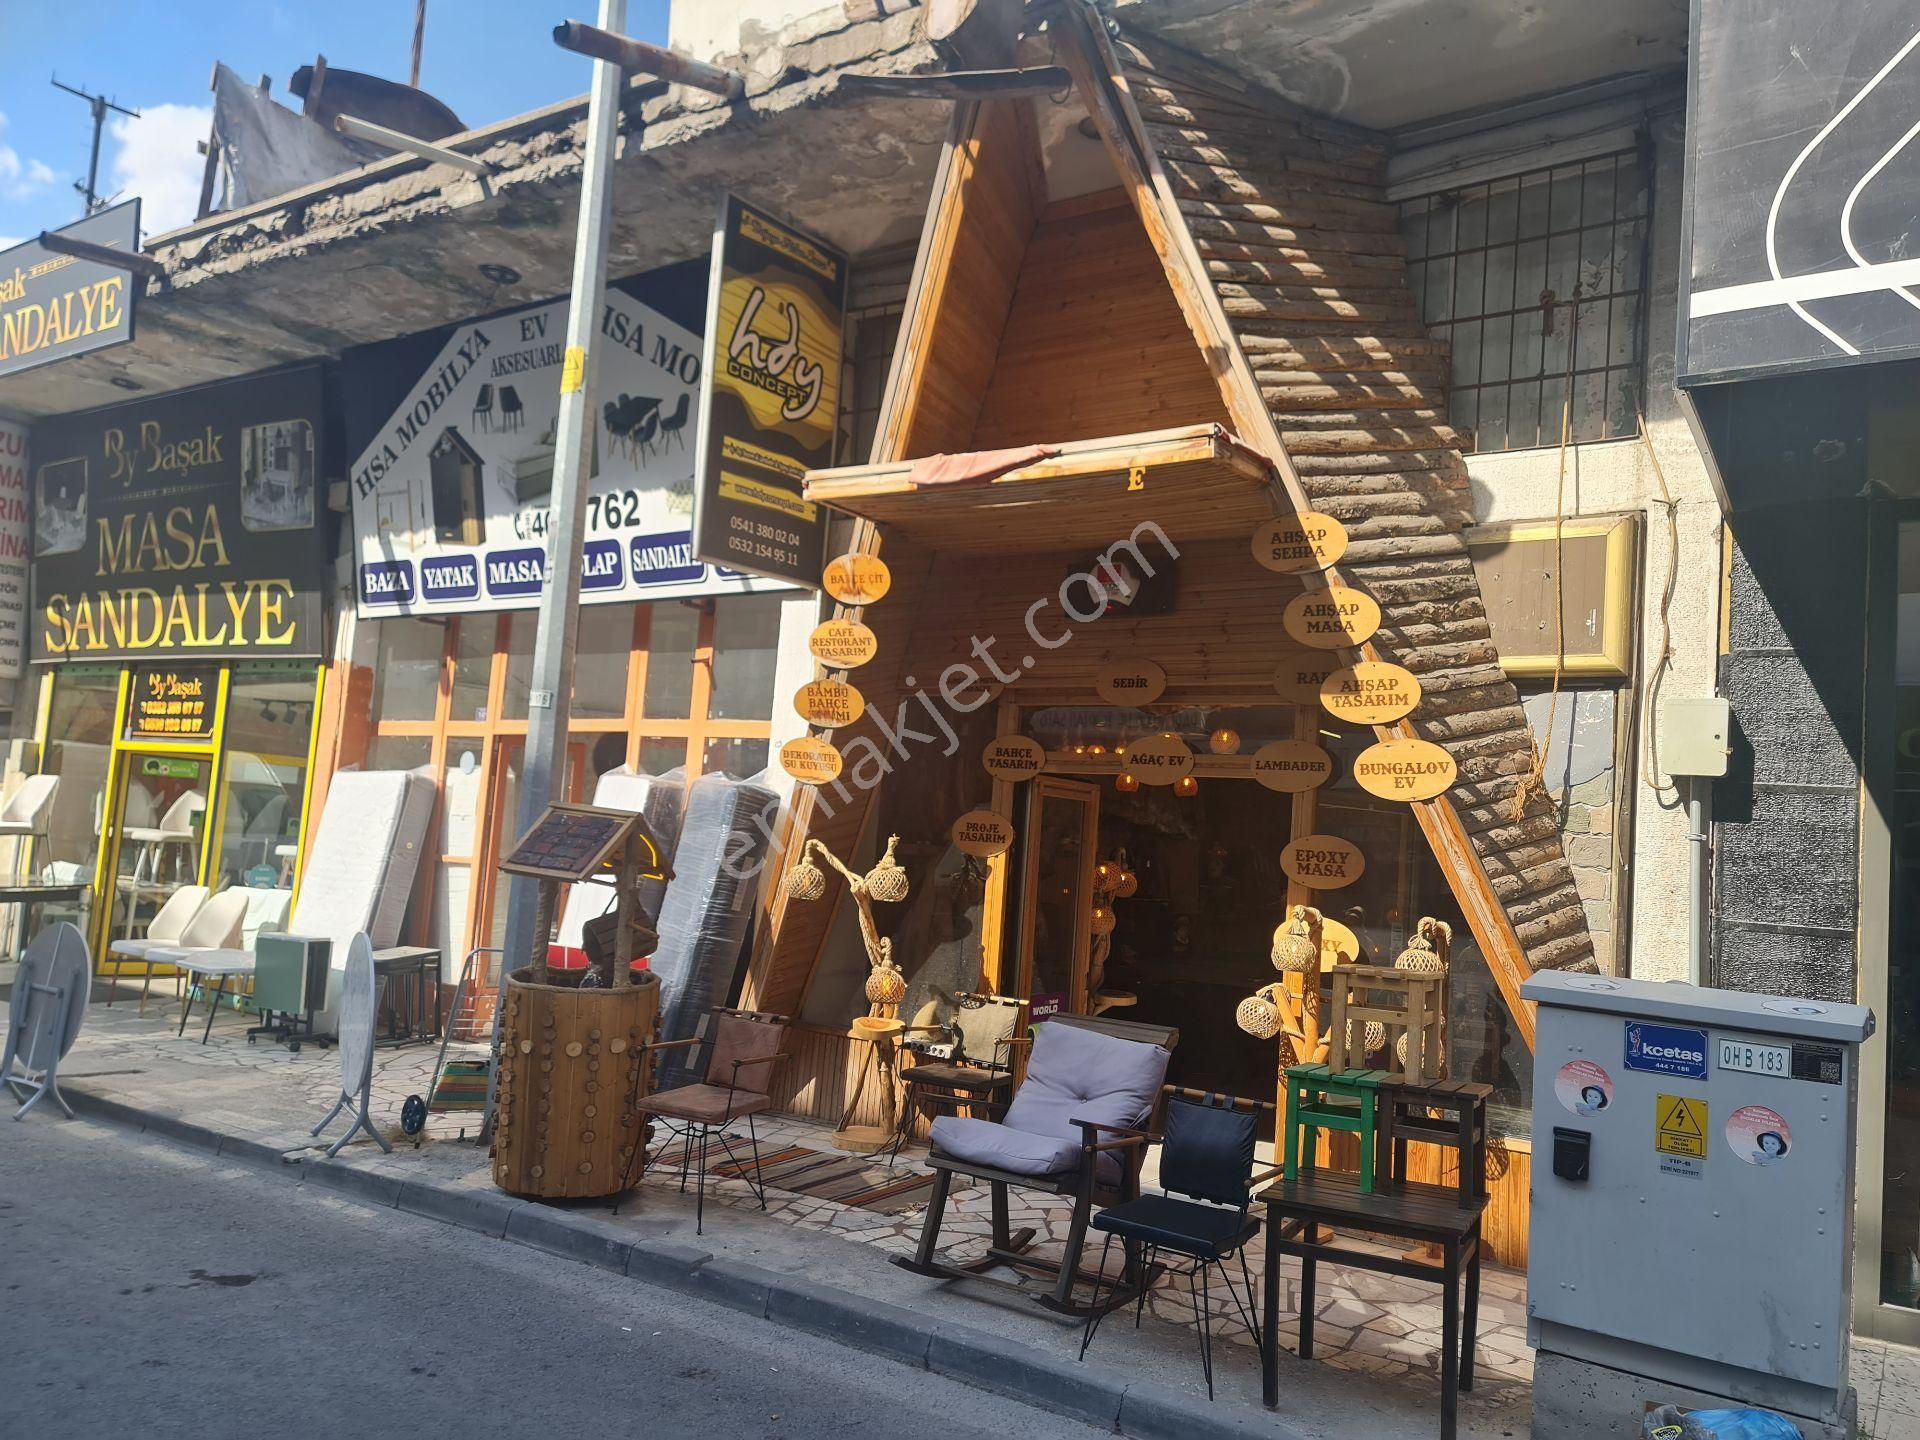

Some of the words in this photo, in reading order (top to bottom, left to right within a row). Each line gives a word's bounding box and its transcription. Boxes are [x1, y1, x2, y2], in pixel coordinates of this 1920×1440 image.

[0, 276, 122, 360] NDALYE
[519, 313, 549, 342] EV
[650, 334, 701, 386] MO
[727, 359, 807, 405] CONCEPT
[355, 443, 399, 501] HSA
[395, 327, 492, 452] MOBİLYA
[104, 428, 139, 487] By
[141, 420, 224, 478] Başak
[1127, 466, 1146, 491] E
[731, 516, 754, 534] 0541
[756, 523, 774, 540] 380
[775, 530, 787, 543] 02
[788, 534, 800, 547] 04
[95, 504, 231, 577] MASA
[729, 536, 753, 553] 0532
[755, 543, 772, 559] 154
[787, 552, 798, 566] 11
[1272, 545, 1326, 560] SEHPA
[365, 571, 410, 593] BAZA
[424, 565, 475, 589] YATAK
[489, 560, 543, 584] MASA
[583, 551, 618, 577] LAP
[45, 578, 297, 654] SANDALYE
[1302, 604, 1359, 618] AHŞAP
[828, 628, 855, 638] CAFE
[1307, 621, 1356, 633] MASA
[812, 637, 873, 648] RESTORANT
[818, 647, 868, 657] TASARIM
[1113, 675, 1148, 688] SEDİR
[1340, 679, 1399, 693] AHŞAP
[807, 687, 849, 698] BAMBU
[808, 698, 849, 709] BAHÇE
[1332, 693, 1409, 707] TASARIM
[995, 748, 1032, 760] BAHÇE
[1130, 752, 1165, 767] AĞAÇ
[1168, 755, 1185, 766] EV
[784, 760, 797, 769] SU
[988, 758, 1038, 770] TASARIM
[1256, 760, 1326, 772] LAMBADER
[1359, 762, 1450, 776] BUNGALOV
[1394, 777, 1417, 789] EV
[966, 822, 1000, 834] PROJE
[959, 832, 1006, 844] TASARIM
[1295, 849, 1351, 863] EPOXY
[1297, 862, 1346, 878] MASA
[1032, 1004, 1058, 1016] WORLD
[1642, 1043, 1703, 1063] kcetaş
[1759, 1050, 1783, 1072] 183
